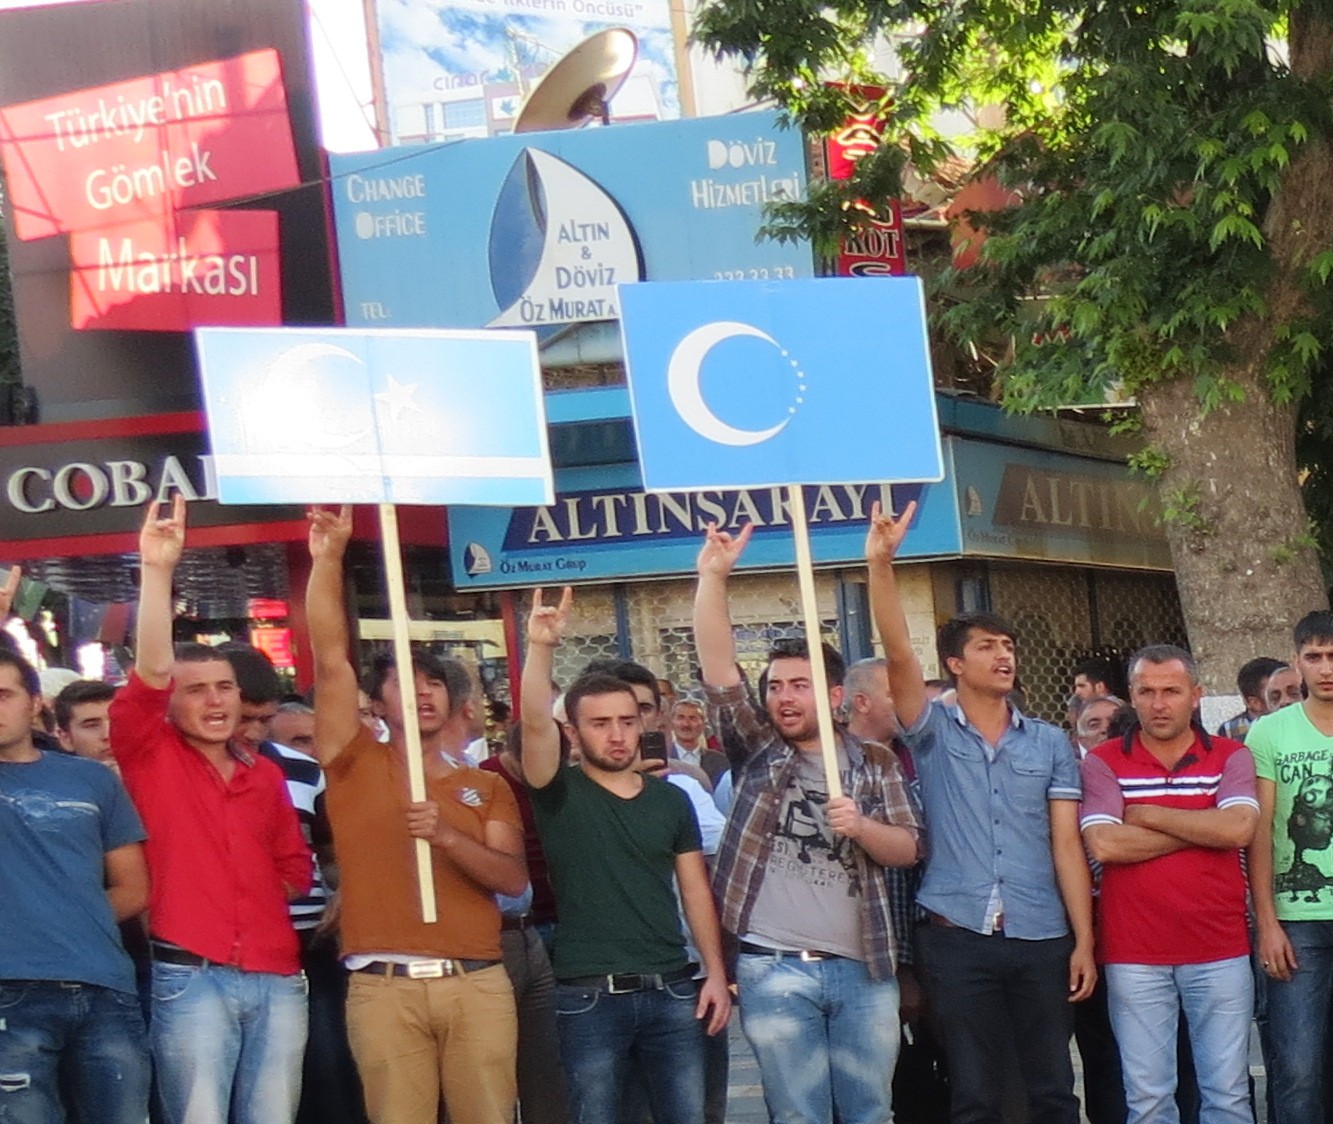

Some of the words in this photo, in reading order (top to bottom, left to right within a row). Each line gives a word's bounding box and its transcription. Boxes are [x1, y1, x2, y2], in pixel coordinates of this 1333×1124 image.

[45, 78, 227, 153] Türkiye'nin
[85, 145, 218, 211] Gömlek
[347, 174, 426, 204] CHANGE
[557, 218, 611, 244] ALTIN
[580, 245, 592, 260] &
[97, 237, 260, 297] Markası
[549, 298, 606, 321] MURAT
[1280, 762, 1313, 784] CAN
